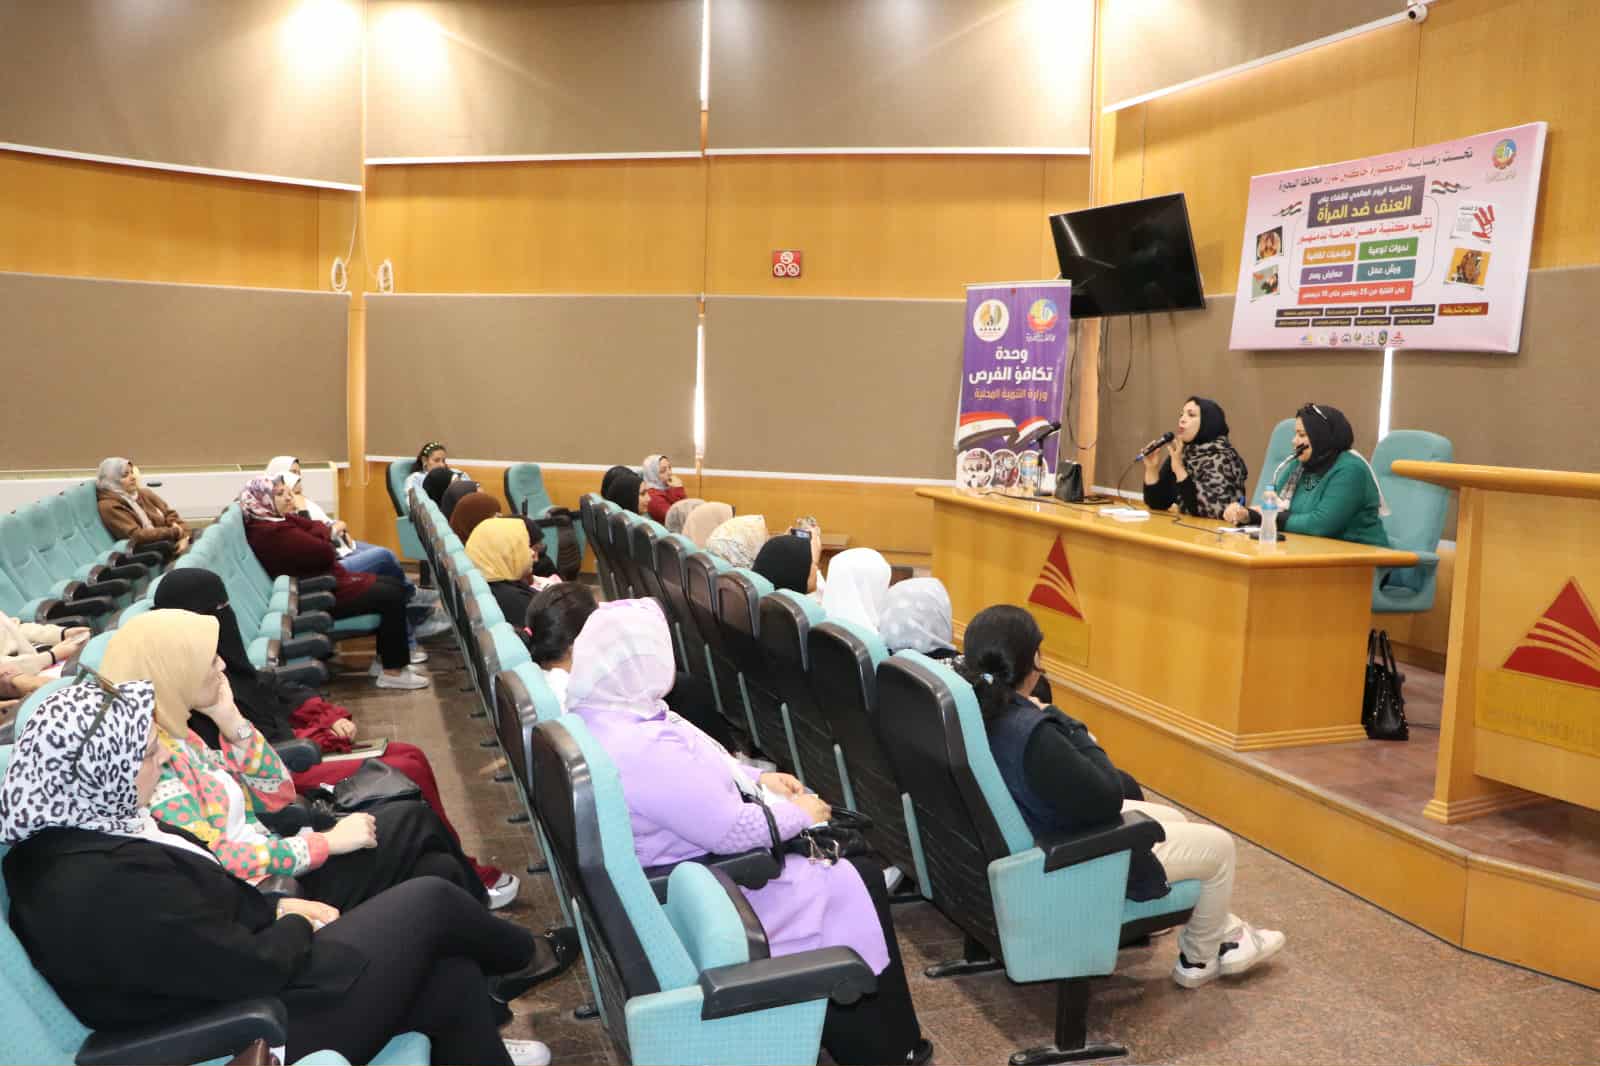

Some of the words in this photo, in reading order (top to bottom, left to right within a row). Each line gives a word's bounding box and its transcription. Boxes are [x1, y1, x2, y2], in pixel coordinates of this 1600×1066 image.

[1317, 203, 1348, 223] المرأة
[1351, 201, 1370, 217] ضد
[1374, 195, 1412, 214] العنف
[1383, 263, 1400, 275] ورش
[995, 346, 1028, 364] وحدة
[968, 366, 1012, 385] الفرص
[1014, 366, 1053, 385] تكافؤ
[1027, 388, 1048, 403] وزارة
